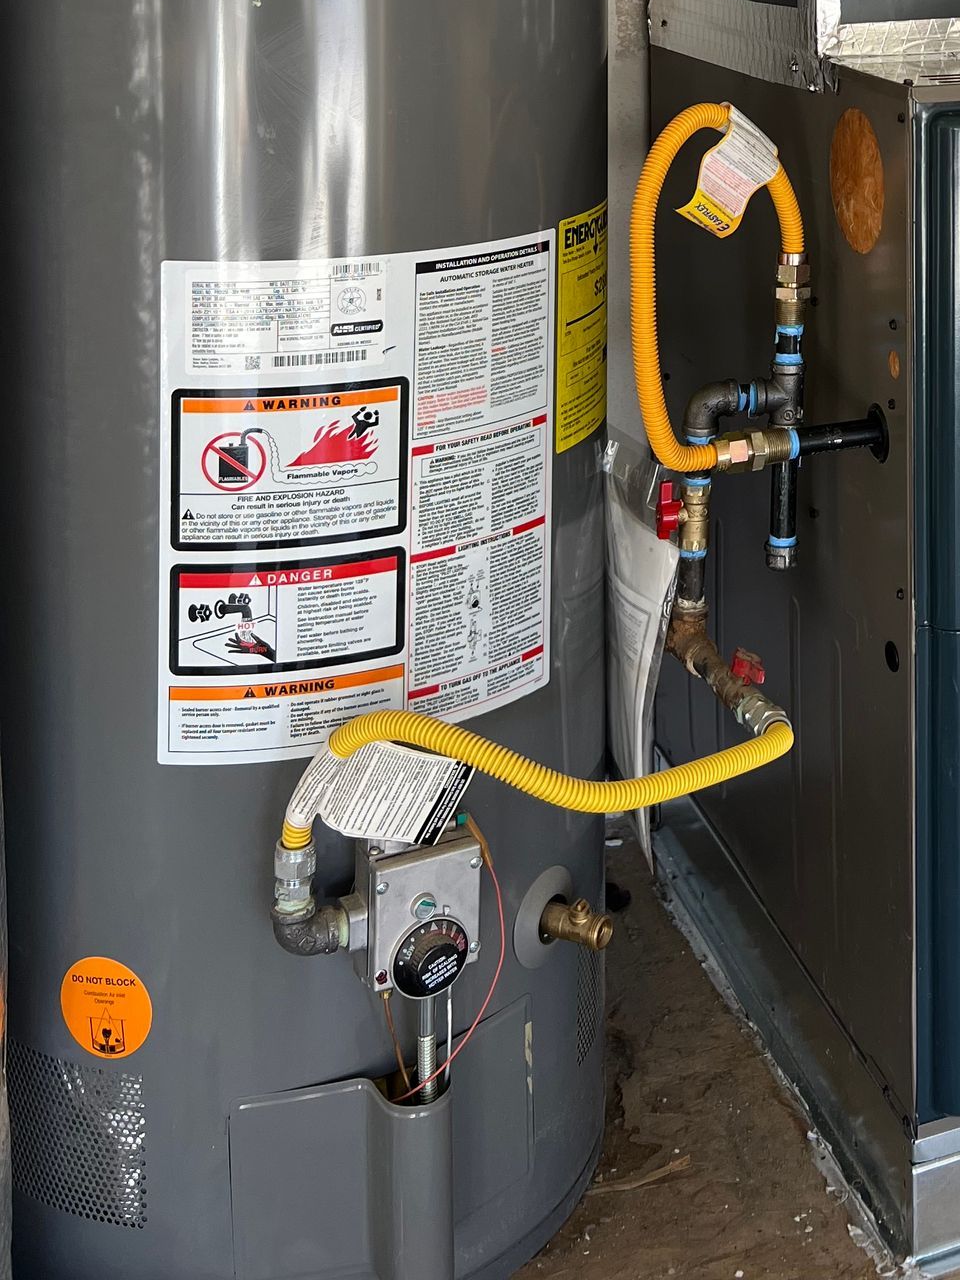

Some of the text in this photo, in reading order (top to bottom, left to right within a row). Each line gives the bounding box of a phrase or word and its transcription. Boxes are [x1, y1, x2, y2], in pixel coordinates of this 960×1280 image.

[436, 258, 476, 269] INSTALLATION
[491, 250, 518, 260] OPERATION
[520, 246, 537, 255] DETAILS
[440, 260, 534, 282] AUTOMATIC STORAGE WATER HEATER
[262, 396, 341, 410] WARNING
[462, 437, 480, 446] SAFETY
[510, 422, 531, 433] OPERATING
[287, 468, 358, 480] Flammable Vapors
[272, 492, 314, 501] EXPLOSION
[315, 489, 344, 497] HAZARD
[302, 499, 321, 508] injury
[373, 505, 397, 514] gasoline
[256, 511, 282, 520] gasoline
[458, 531, 511, 552] LIGHTING INSTRUCTIONS
[267, 569, 332, 584] DANGER
[498, 658, 520, 671] APPLIANCE
[264, 680, 334, 696] WARNING
[404, 945, 415, 960] LOW
[422, 971, 431, 980] RISK
[438, 954, 458, 969] SCALDING
[425, 961, 457, 984] INCREASES WITH
[72, 974, 84, 982] DO
[105, 978, 136, 986] BLOCK
[428, 966, 457, 988] HOTTER WATER
